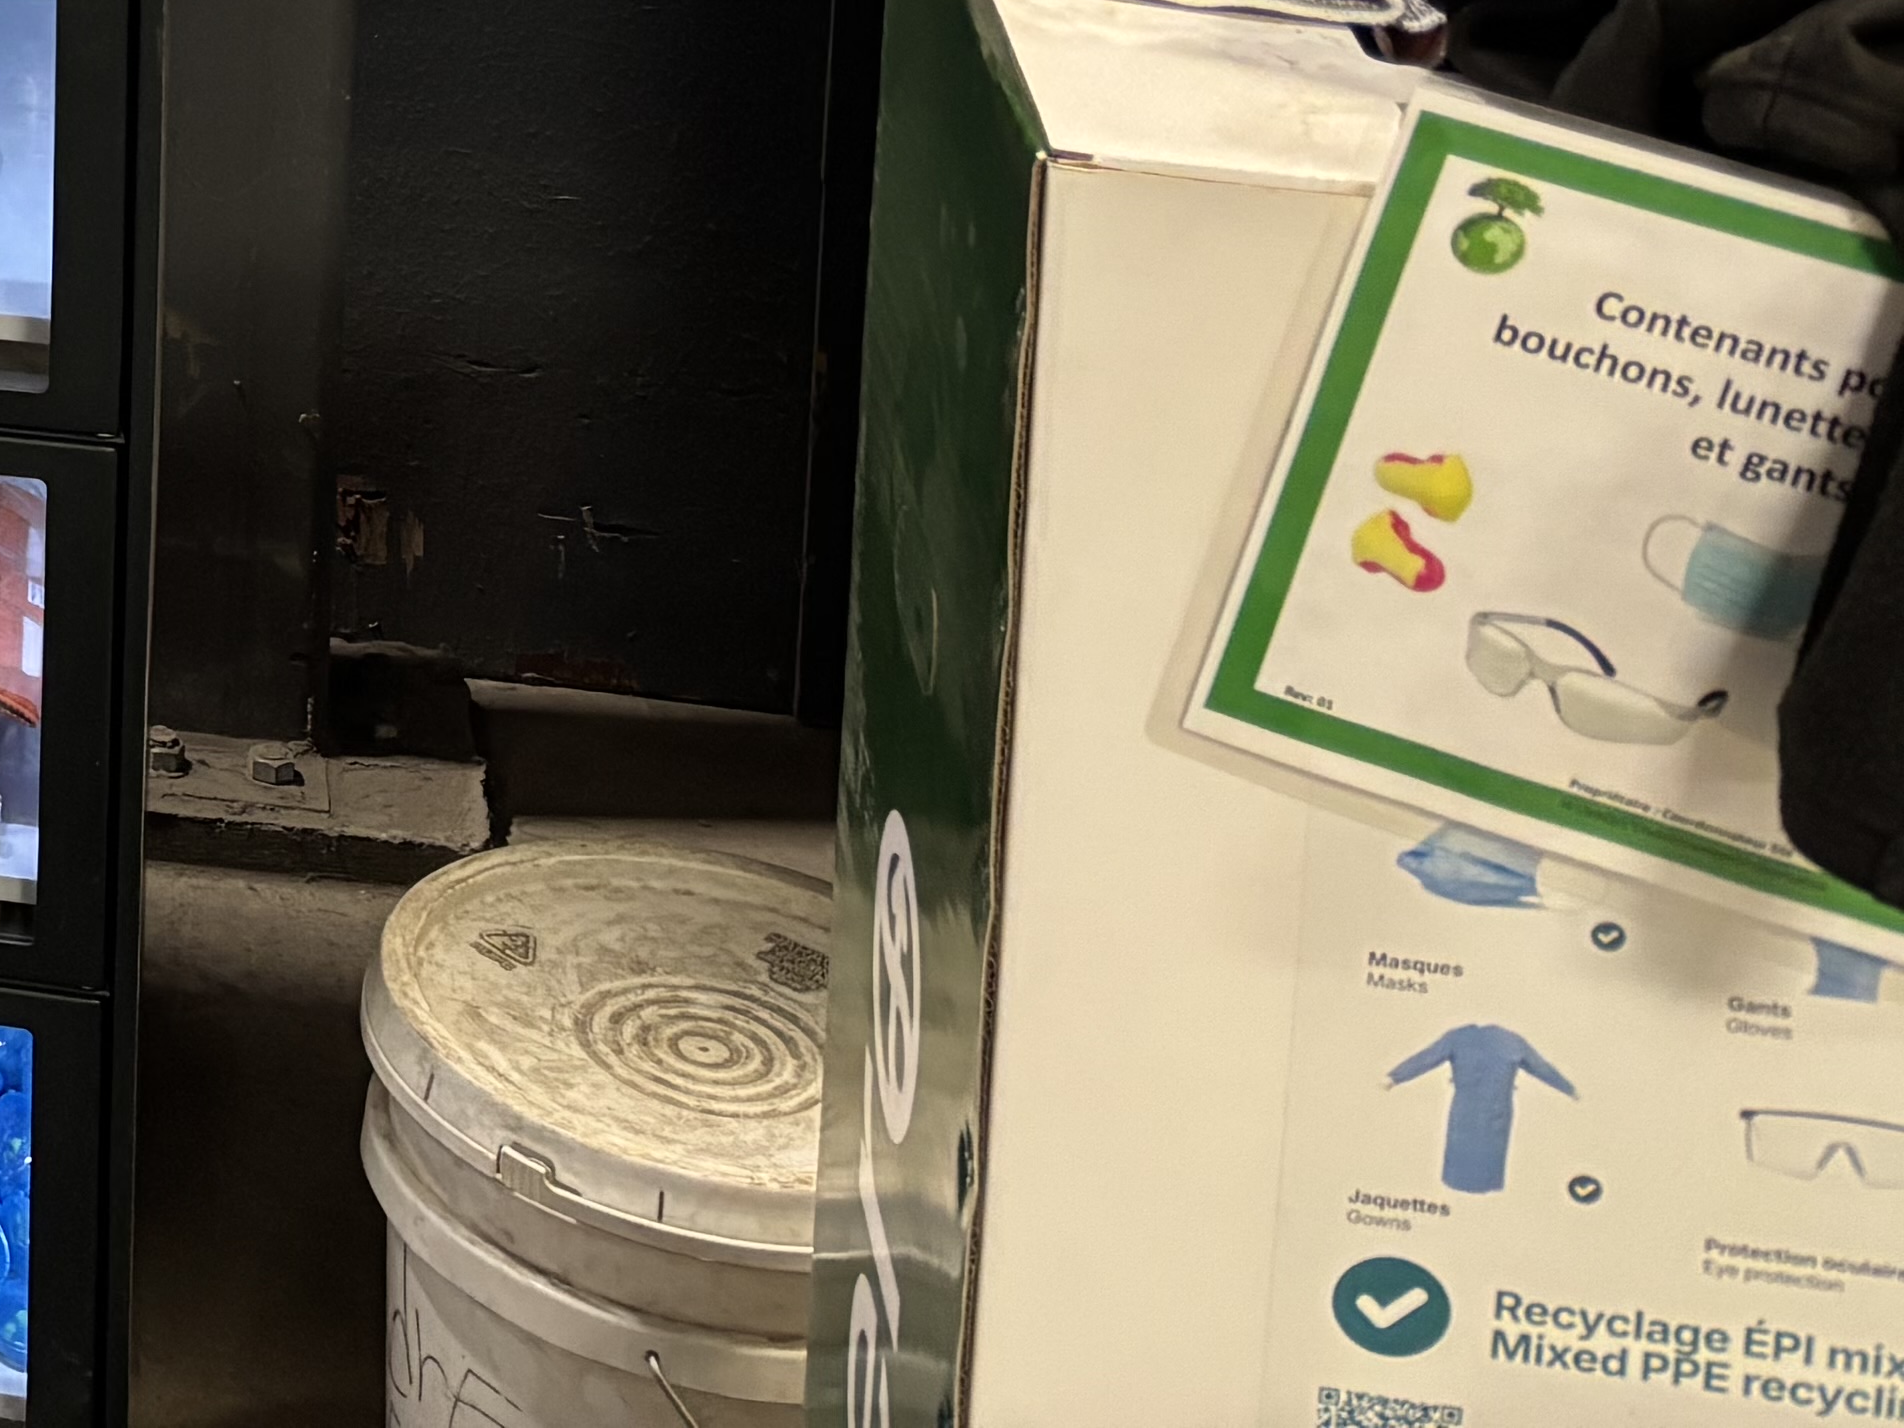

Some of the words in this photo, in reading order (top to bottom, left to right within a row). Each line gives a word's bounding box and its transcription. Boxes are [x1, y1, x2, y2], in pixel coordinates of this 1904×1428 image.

[1492, 314, 1703, 409] bouchons,
[1595, 291, 1830, 383] Contenants
[1689, 434, 1735, 468] et
[1738, 448, 1855, 504] gants
[1365, 971, 1429, 995] Masks
[1367, 950, 1464, 979] Masques
[1726, 995, 1793, 1019] Gants
[1346, 1209, 1412, 1233] Gowns
[1348, 1188, 1452, 1218] Jaquettes
[1493, 1288, 1731, 1358] Recyclage
[1742, 1319, 1816, 1366] ÉPI
[1490, 1328, 1629, 1379] Mixed
[1640, 1351, 1731, 1395] PPE
[1739, 1372, 1904, 1420] recycli
